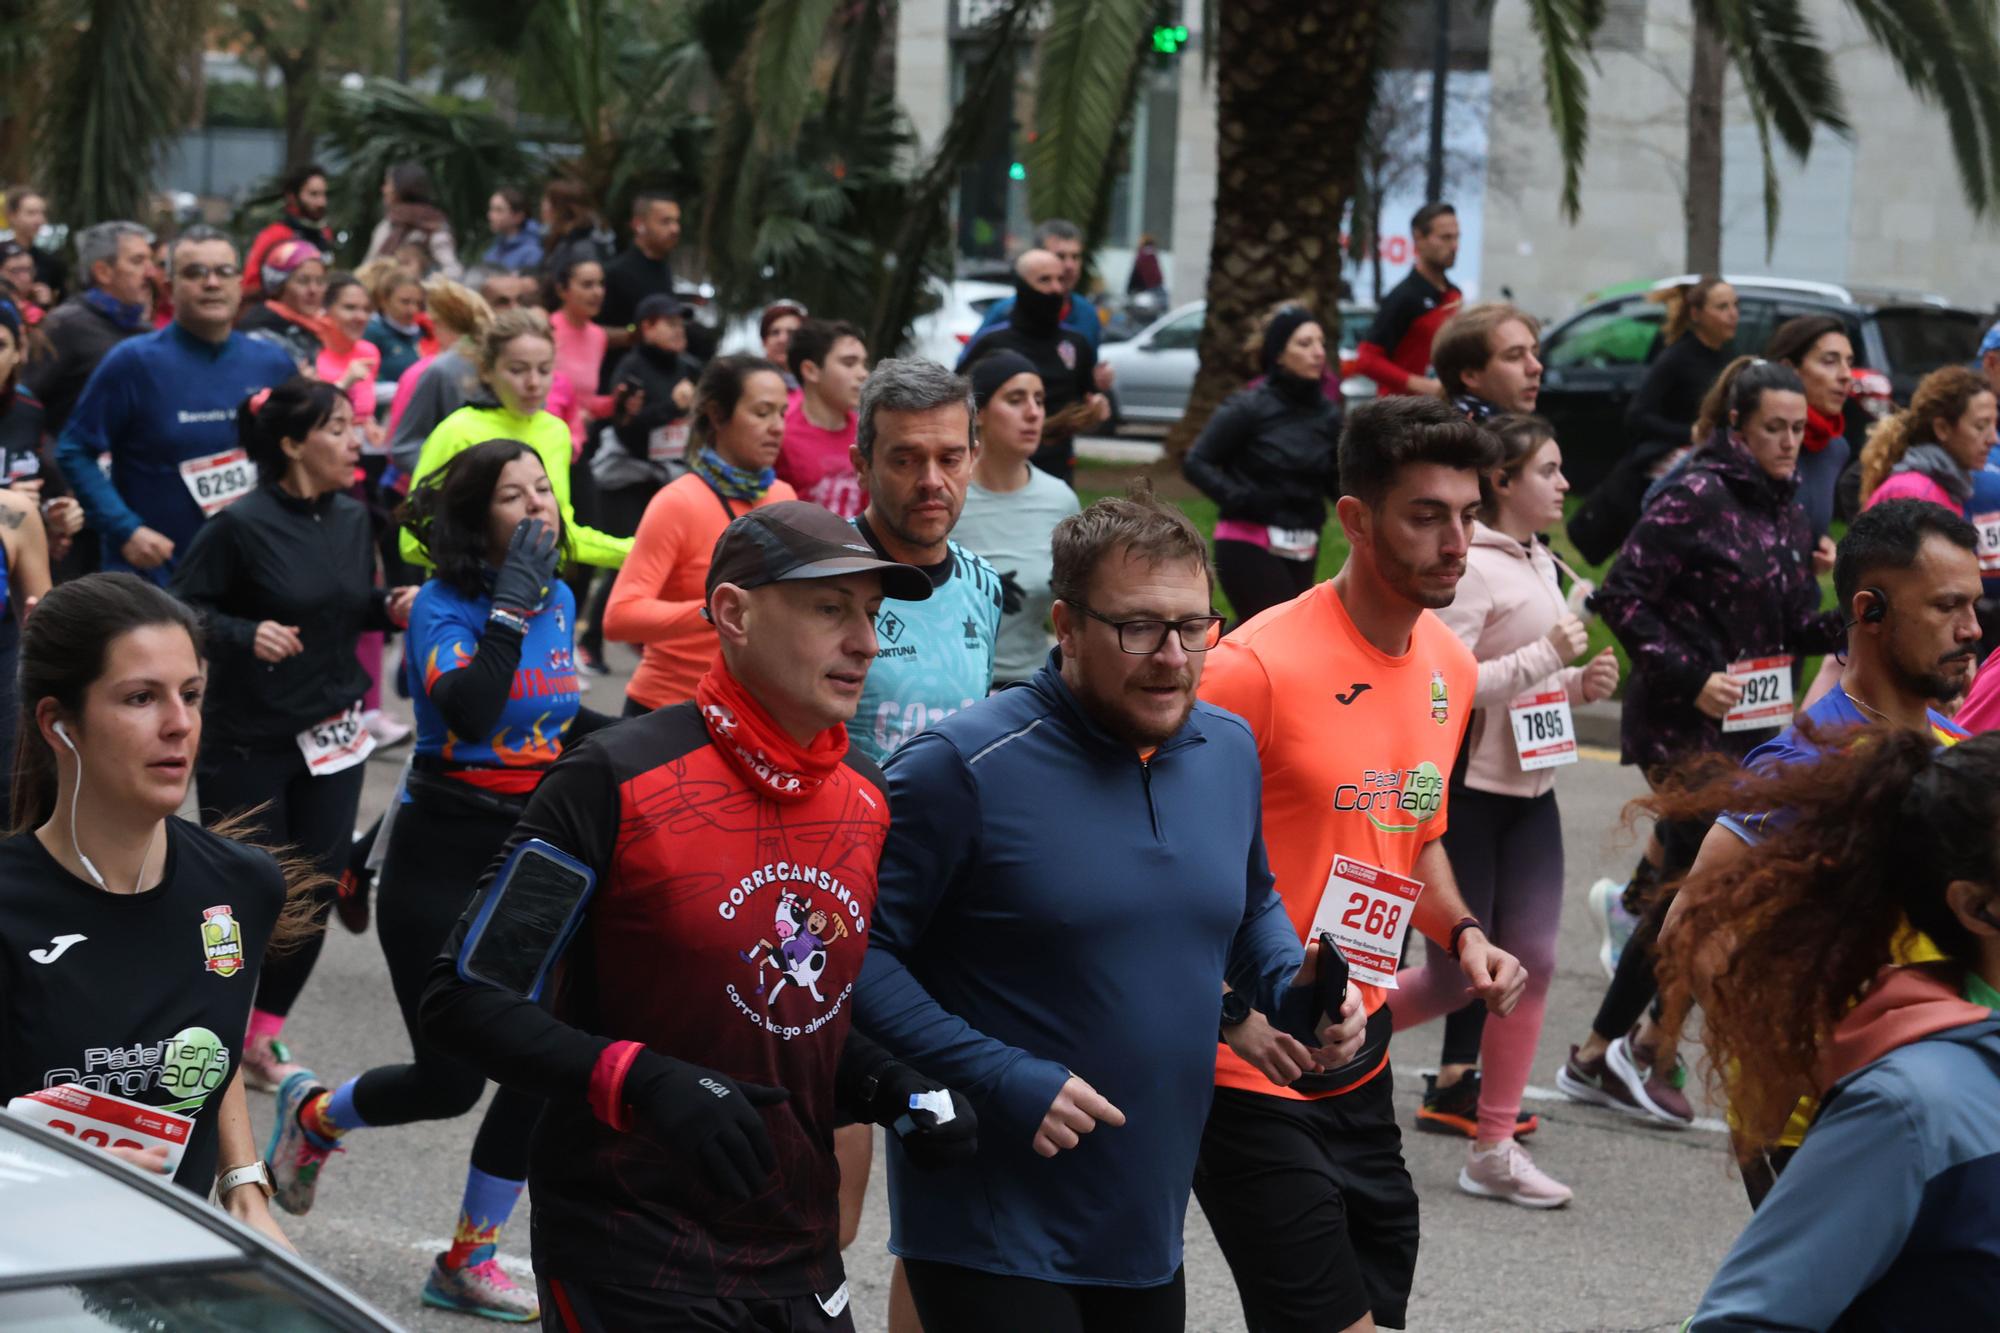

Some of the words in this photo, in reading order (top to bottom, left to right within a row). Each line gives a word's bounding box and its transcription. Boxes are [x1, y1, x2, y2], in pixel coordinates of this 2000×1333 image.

[196, 466, 248, 498] 6293
[876, 645, 918, 659] ORTUNA
[1522, 710, 1564, 741] 7895
[718, 861, 865, 934] CORRECANSINOS
[1341, 891, 1402, 940] 268
[804, 982, 853, 1035] almuerzo
[84, 1040, 164, 1073] Pádel
[165, 1038, 230, 1064] Tenis
